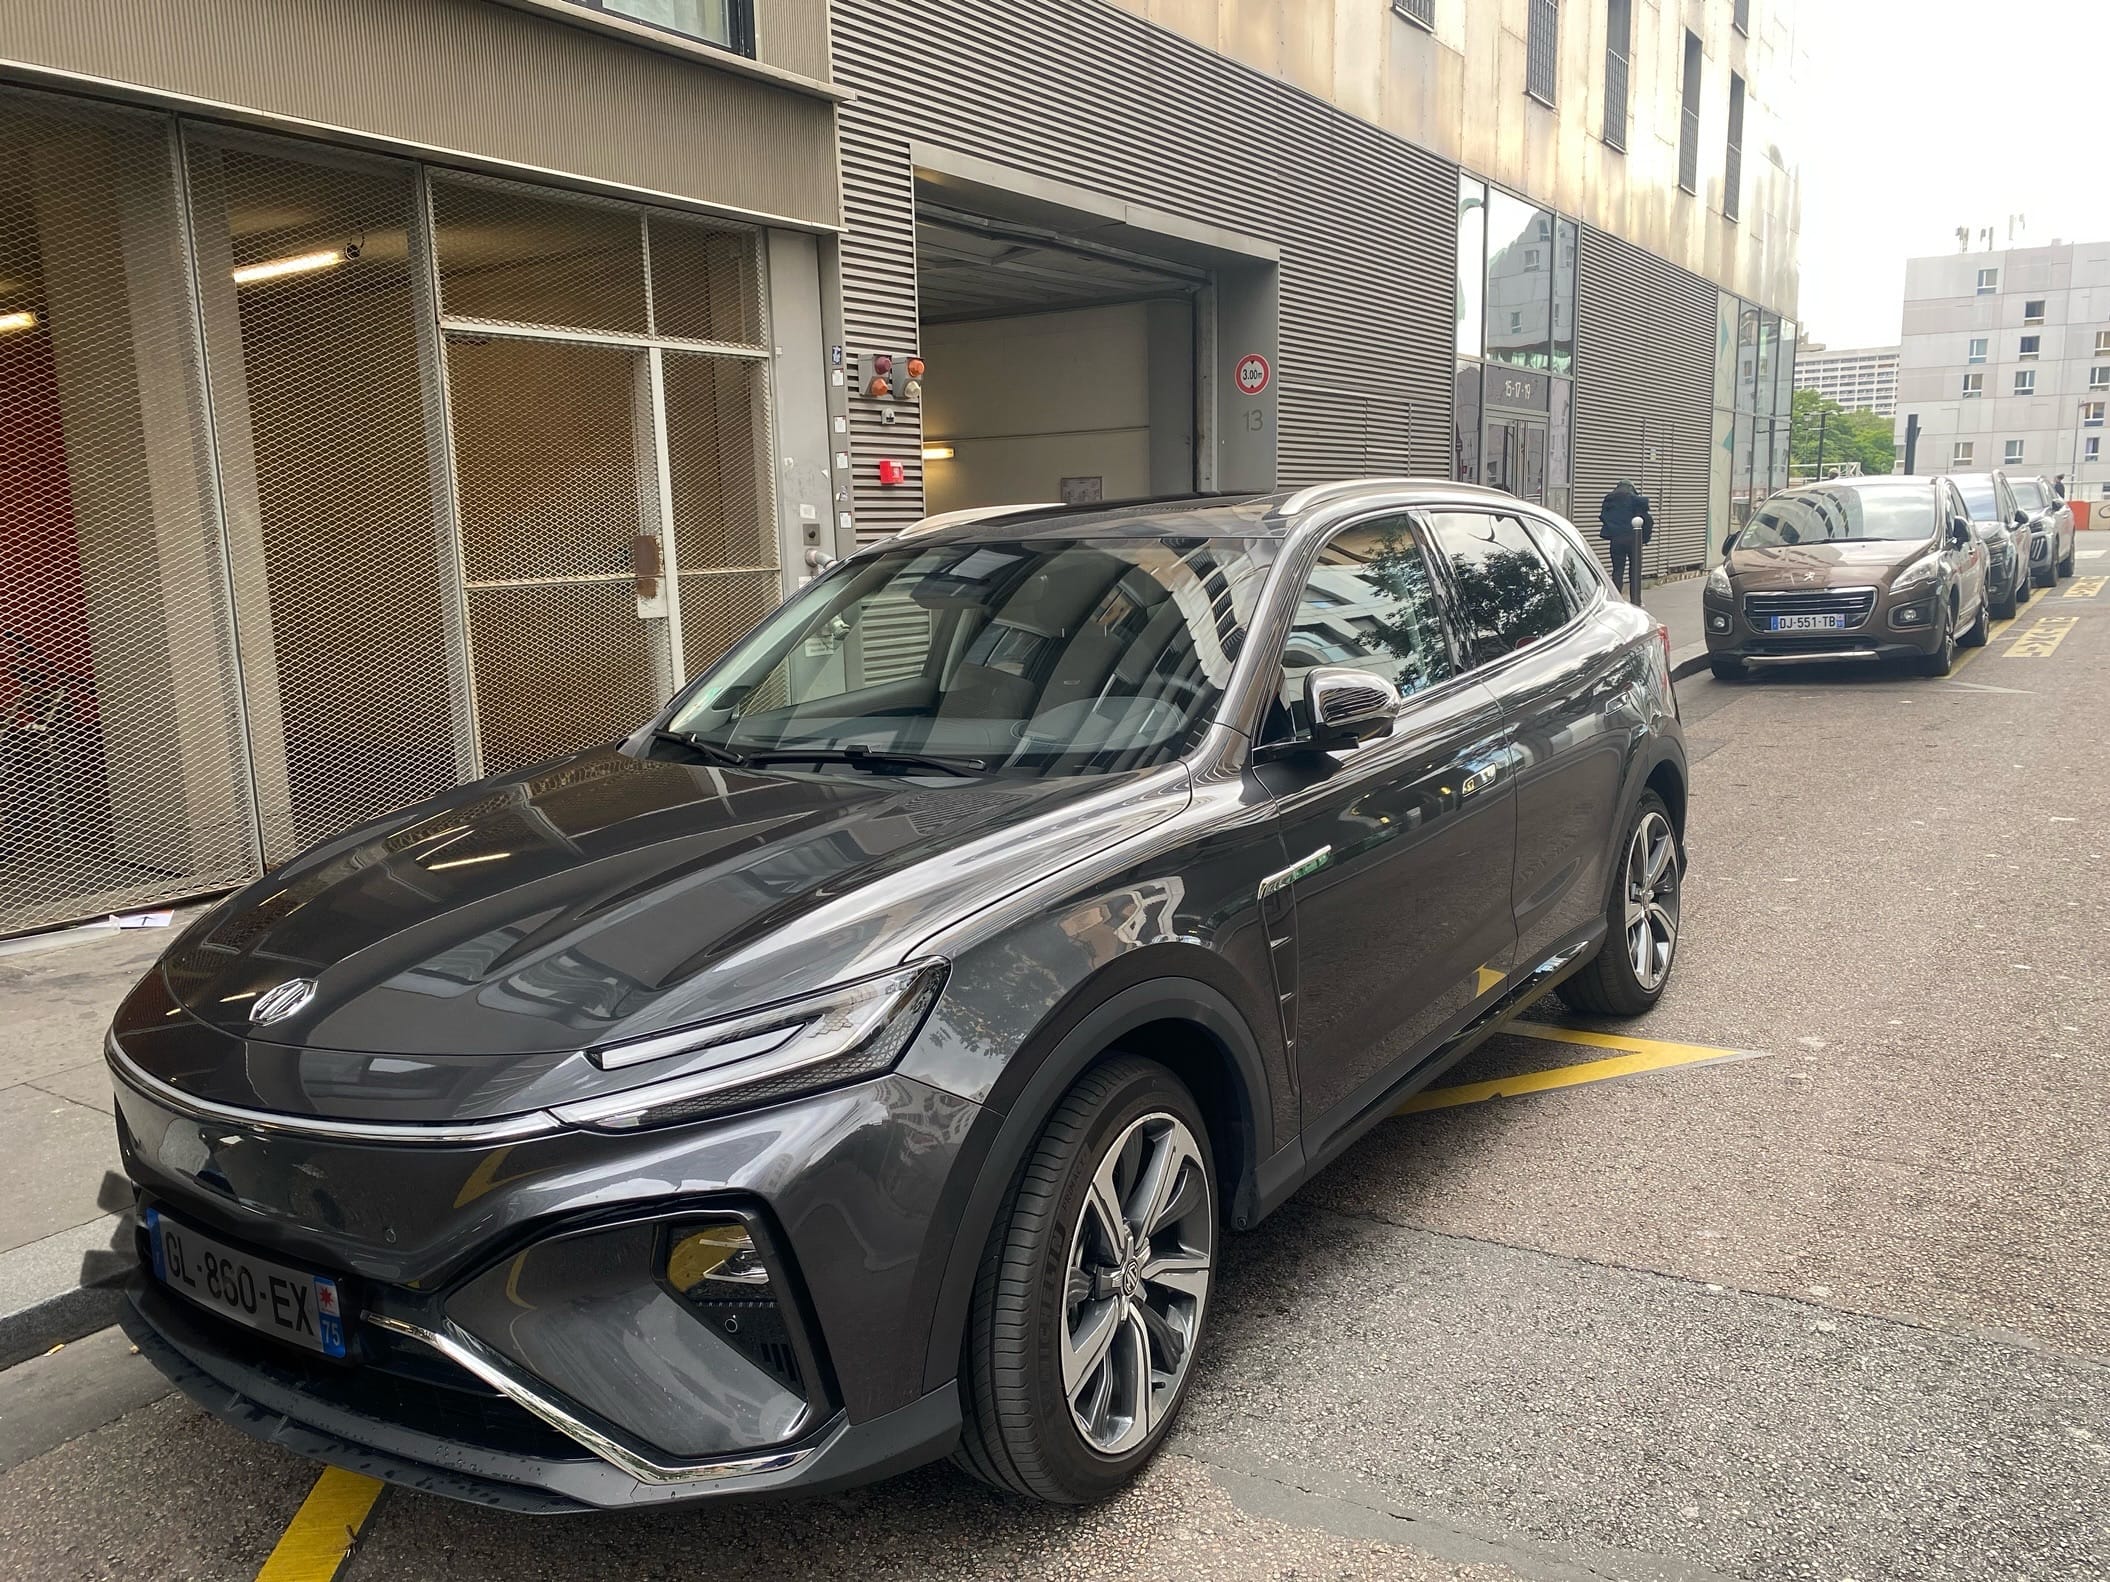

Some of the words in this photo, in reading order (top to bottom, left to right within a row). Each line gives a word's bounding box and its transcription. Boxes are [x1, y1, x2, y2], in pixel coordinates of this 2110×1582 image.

[1243, 409, 1263, 432] 13
[1779, 615, 1836, 629] DJ-551-TB
[165, 1231, 315, 1337] GL-860-EX
[322, 1320, 341, 1346] 75
